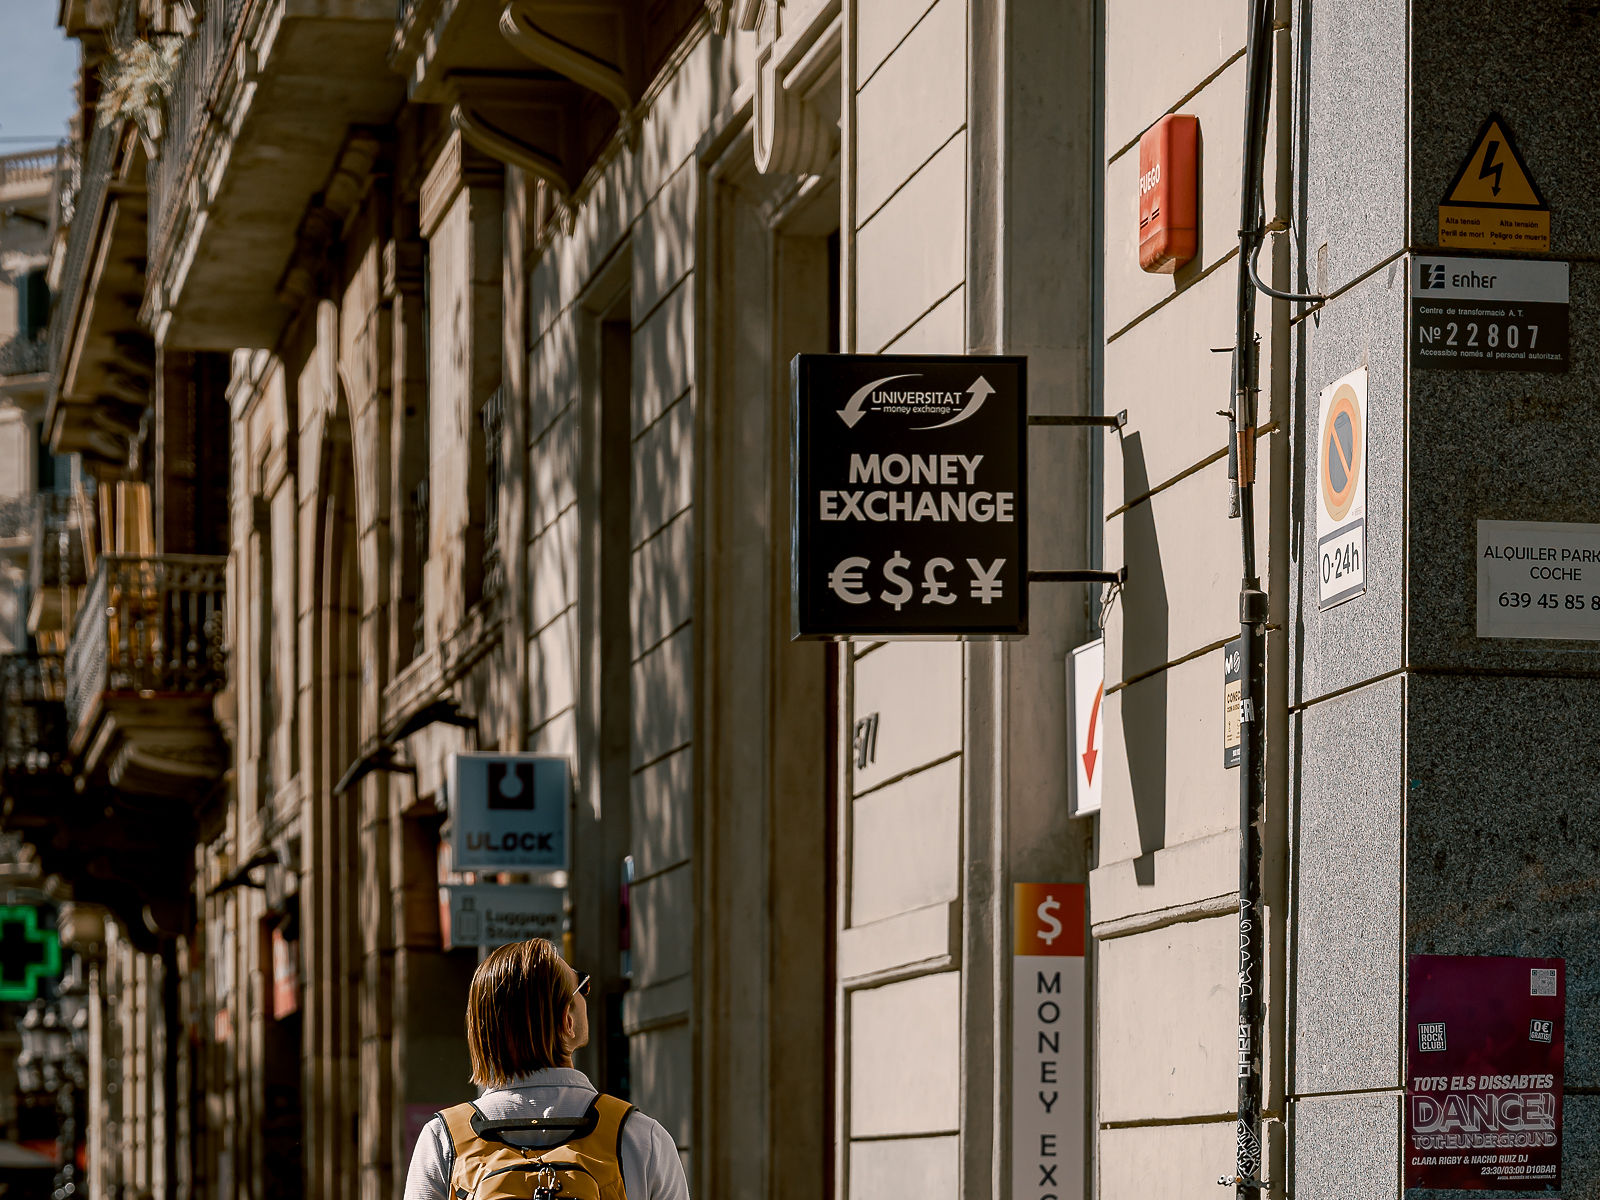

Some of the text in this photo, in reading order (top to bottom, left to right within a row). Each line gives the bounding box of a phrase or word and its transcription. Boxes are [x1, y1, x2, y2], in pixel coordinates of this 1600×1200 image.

[1139, 163, 1160, 197] FUEGO
[1419, 306, 1443, 314] Centre
[1446, 307, 1456, 315] de
[1420, 348, 1457, 357] Accessible
[1486, 350, 1493, 358] al
[1496, 351, 1526, 360] personal
[872, 391, 962, 405] UNIVERSITAT
[883, 404, 951, 415] money exchange
[849, 453, 984, 485] MONEY
[819, 490, 1014, 522] EXCHANGE
[1484, 546, 1600, 562] ALQUILER PARK
[1530, 566, 1582, 580] COCHE
[1498, 592, 1532, 608] 639
[1537, 593, 1559, 609] 45
[1564, 594, 1585, 610] 85
[466, 832, 553, 851] ULOCK
[486, 909, 558, 925] Luggage
[1420, 1024, 1443, 1033] INDIE
[1036, 970, 1061, 1114] MONEY
[1421, 1033, 1443, 1042] ROCK
[1421, 1041, 1444, 1050] CLUB!
[1413, 1074, 1554, 1091] TOTS ELS DISSABTES
[1412, 1092, 1555, 1133] DANCE!
[1411, 1154, 1528, 1166] CLARA RIGBY & NACHO RUIZ DJ
[1480, 1166, 1524, 1175] 23:30/03:00
